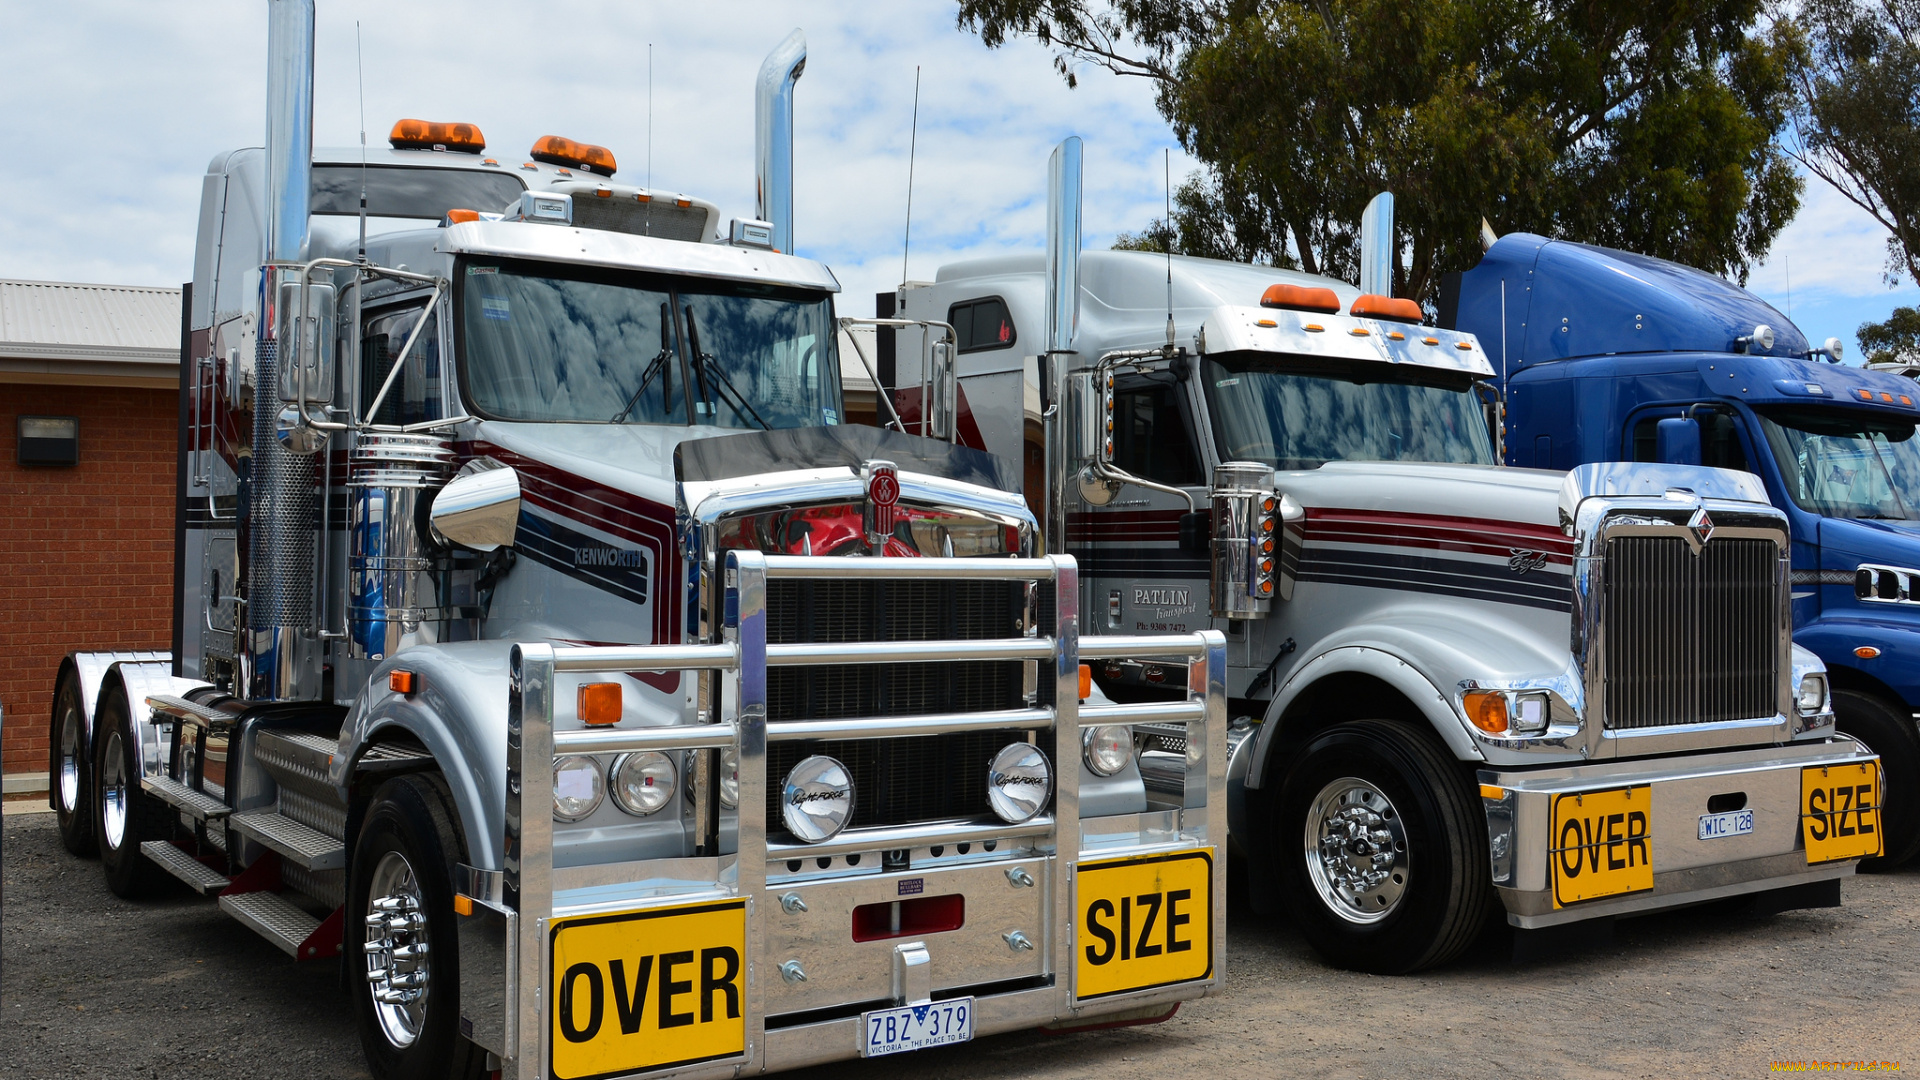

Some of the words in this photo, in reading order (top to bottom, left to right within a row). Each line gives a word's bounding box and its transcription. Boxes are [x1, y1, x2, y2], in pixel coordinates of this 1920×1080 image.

[574, 547, 642, 568] KENWORTH
[1134, 589, 1189, 606] PATLIN
[1156, 602, 1197, 620] Transport
[1136, 621, 1148, 631] Ph:
[1150, 622, 1167, 632] 9308
[1169, 623, 1186, 632] 7472
[1808, 784, 1874, 842] SIZE
[1560, 810, 1648, 879] OVER
[1085, 889, 1191, 966] SIZE
[559, 945, 741, 1043] OVER
[871, 1013, 911, 1046] ZBZ
[929, 1005, 967, 1036] 379
[871, 1043, 902, 1054] VICTORIA
[911, 1040, 922, 1048] THE
[925, 1036, 945, 1045] PLACE
[947, 1034, 956, 1042] TO
[958, 1032, 966, 1040] BE
